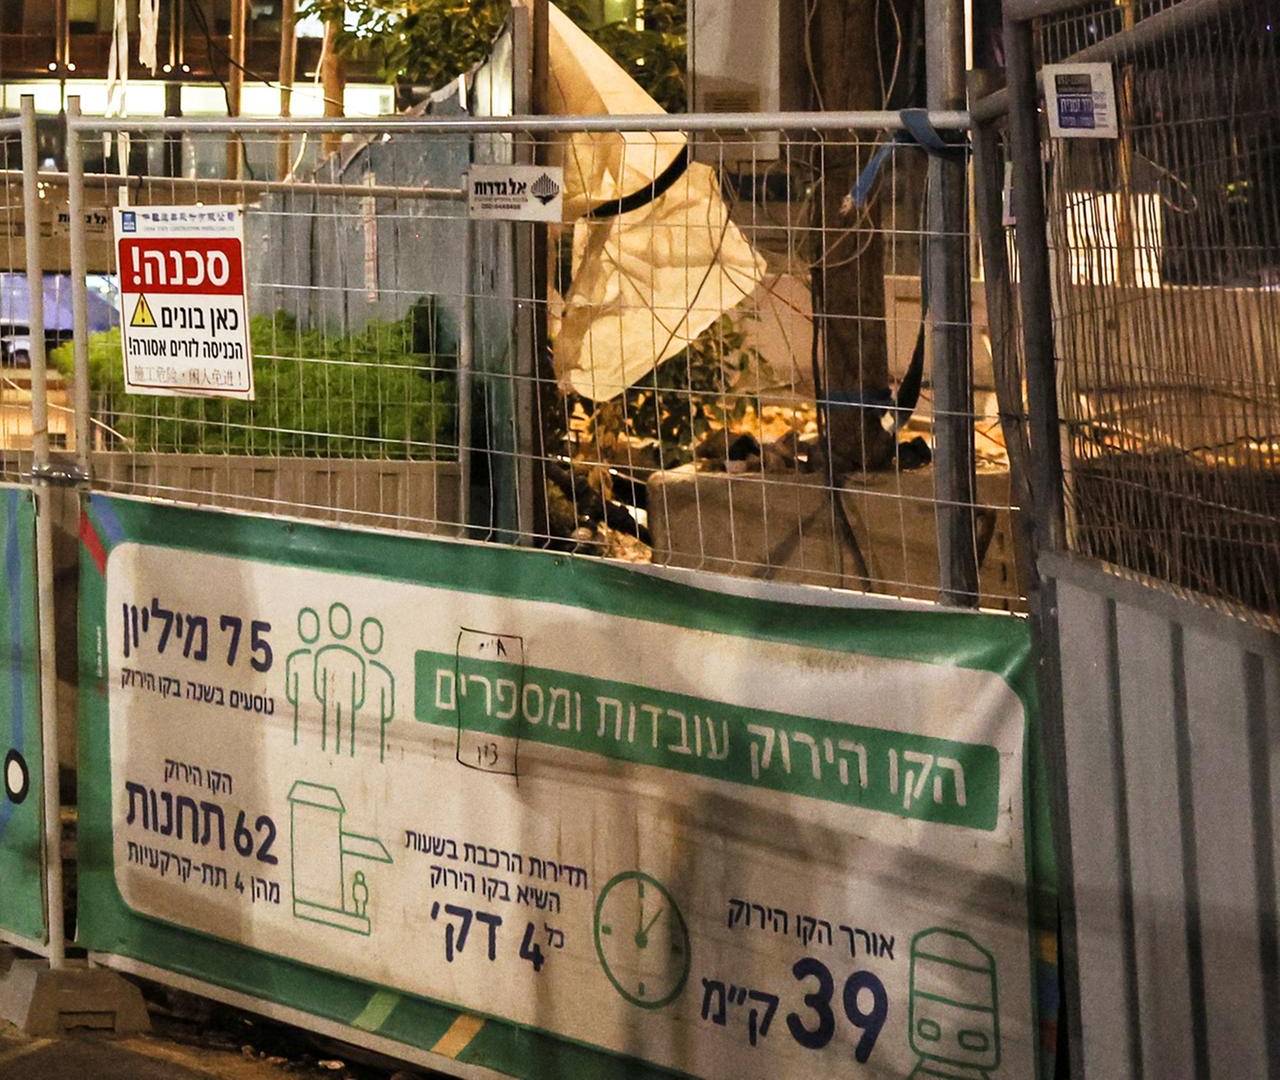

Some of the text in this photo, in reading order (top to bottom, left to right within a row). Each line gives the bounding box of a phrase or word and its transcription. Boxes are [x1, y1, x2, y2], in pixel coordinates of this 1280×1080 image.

[474, 177, 527, 195] אל גדרות
[131, 246, 230, 286] סכנה!
[161, 306, 239, 337] כאן בונים
[128, 336, 243, 360] הכניסה לזרים אסורה!
[122, 597, 208, 661] מיליון
[219, 614, 273, 672] 75
[121, 667, 274, 716] נוסעים בשנה בקו הירוק
[435, 668, 967, 809] הקו הירוק עובדות ומספרים
[164, 758, 233, 796] הקו הירוק
[125, 780, 279, 866] 62 תחנות
[127, 841, 280, 905] מהן 4 תת-קרקעיות
[404, 829, 589, 890] תדירות הרכבת בשעות
[430, 865, 561, 914] השיא בקו הירוק
[519, 921, 545, 972] 4
[544, 922, 565, 949] כל
[727, 897, 895, 961] אורך הקו הירוק
[786, 956, 889, 1065] 39
